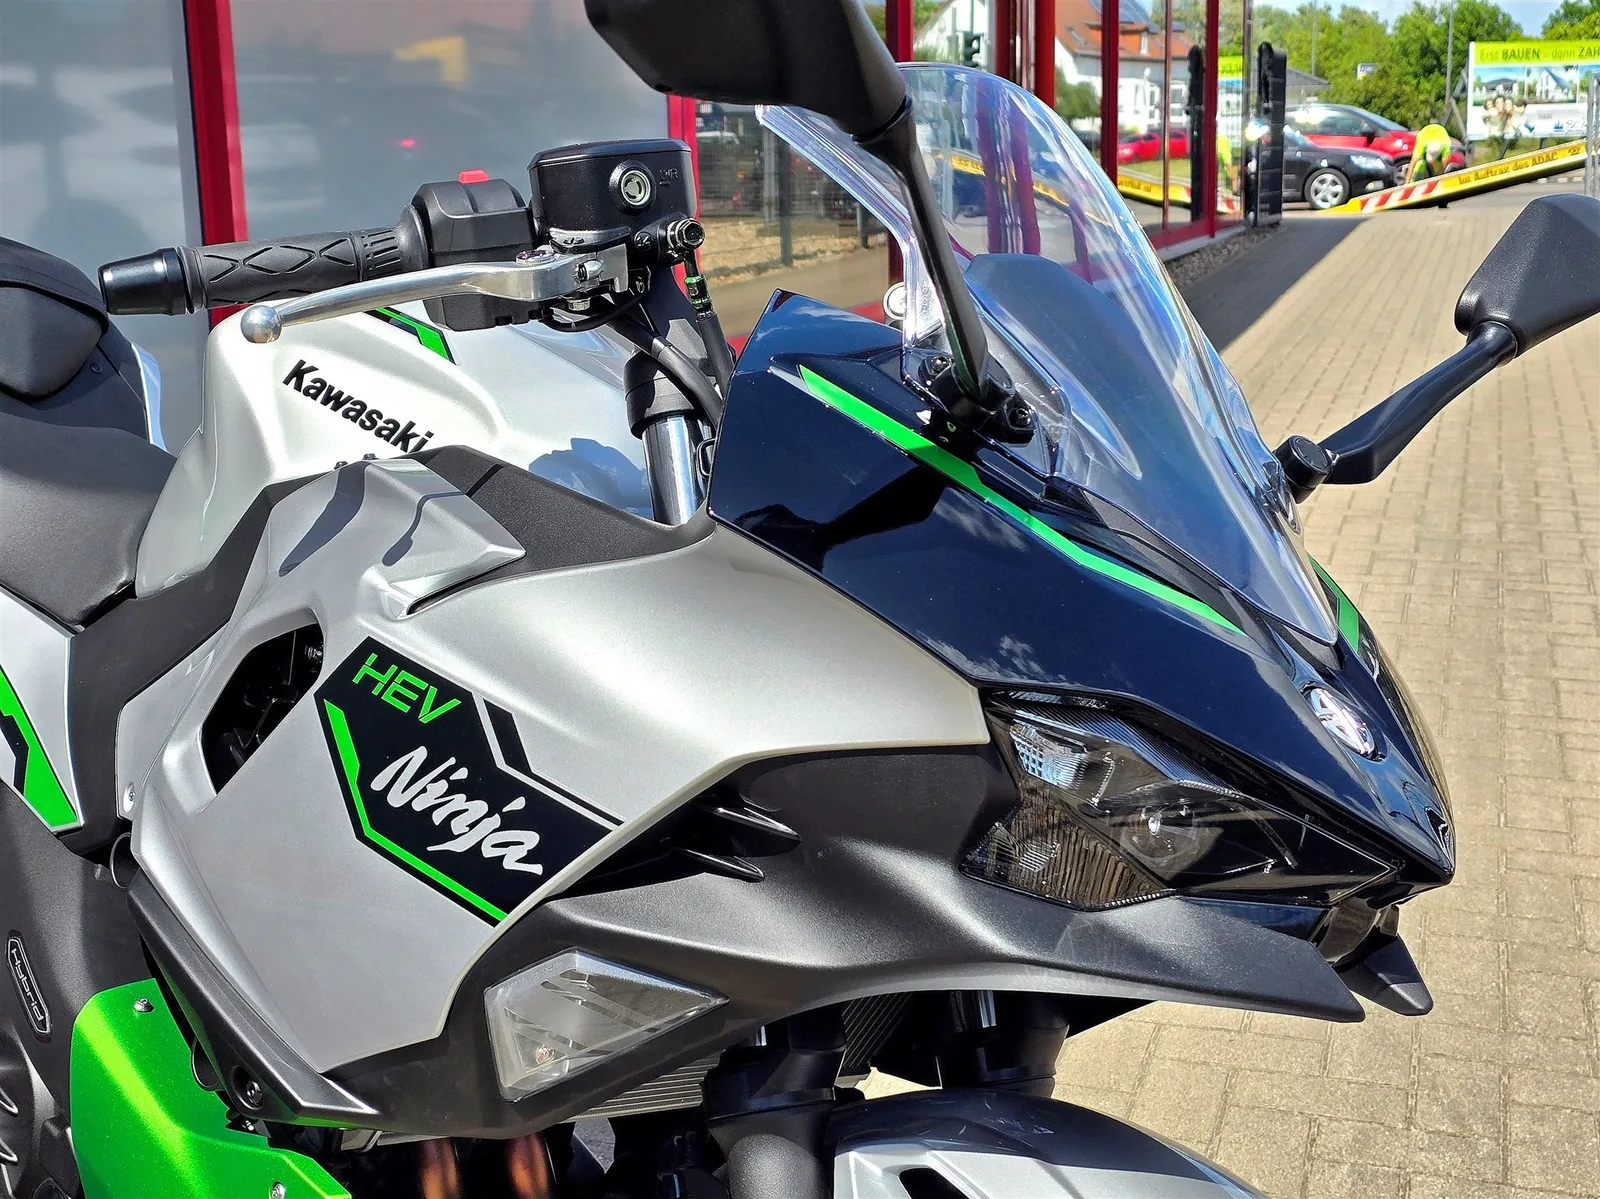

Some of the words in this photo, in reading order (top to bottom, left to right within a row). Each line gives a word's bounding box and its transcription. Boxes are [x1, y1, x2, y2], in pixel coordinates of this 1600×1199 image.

[1480, 48, 1499, 61] Erst
[1502, 47, 1540, 61] BAUEN
[1551, 47, 1576, 60] dann
[1474, 166, 1510, 182] Auftrag
[1513, 161, 1529, 172] des
[1531, 151, 1558, 167] ADAC
[282, 359, 434, 453] Kawasaki
[352, 652, 462, 724] HEV
[370, 745, 543, 876] Ninja
[11, 948, 44, 1021] Hybrid
